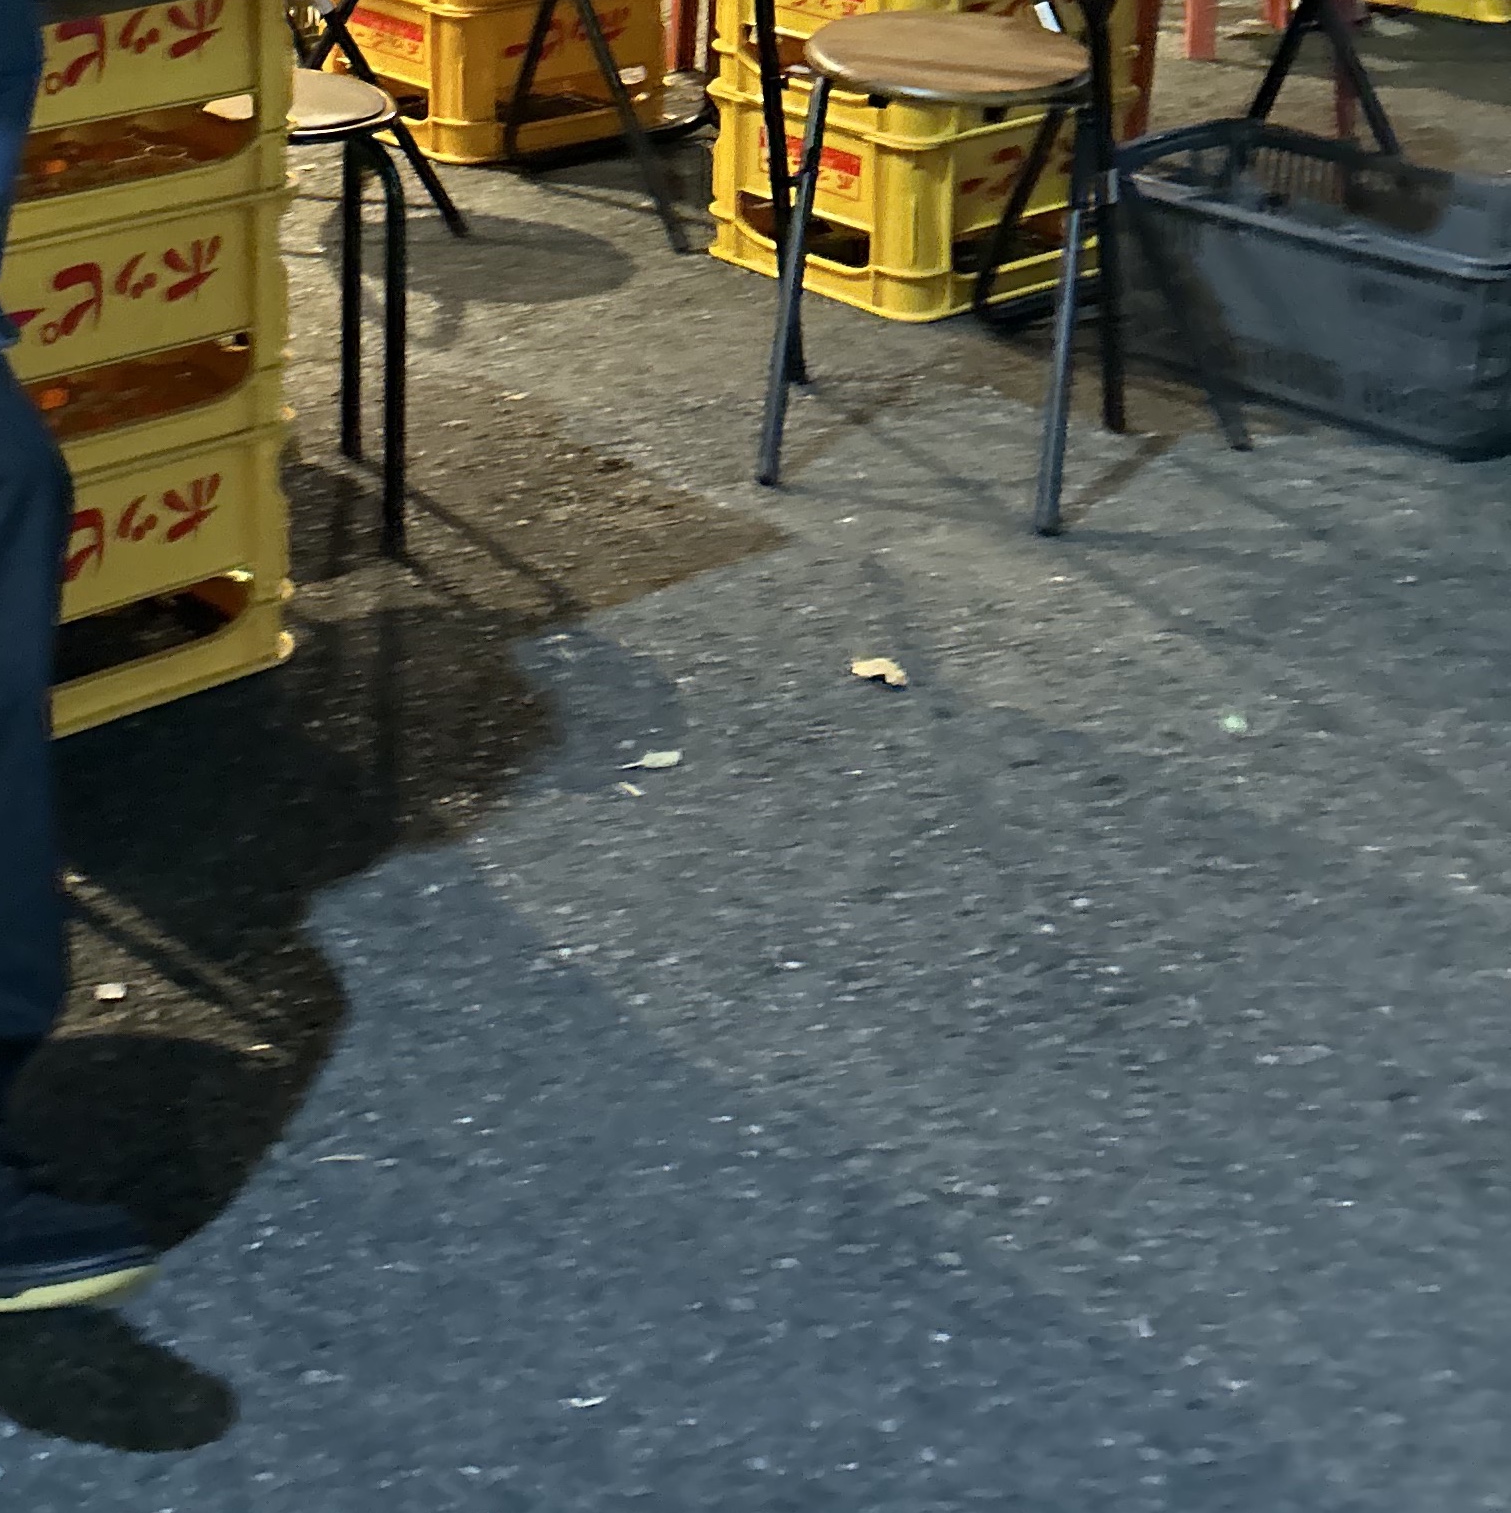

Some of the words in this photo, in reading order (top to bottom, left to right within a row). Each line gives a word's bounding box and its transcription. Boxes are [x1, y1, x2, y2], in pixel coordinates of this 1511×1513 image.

[28, 235, 222, 346] ホッピ
[63, 472, 221, 583] ホッピ
